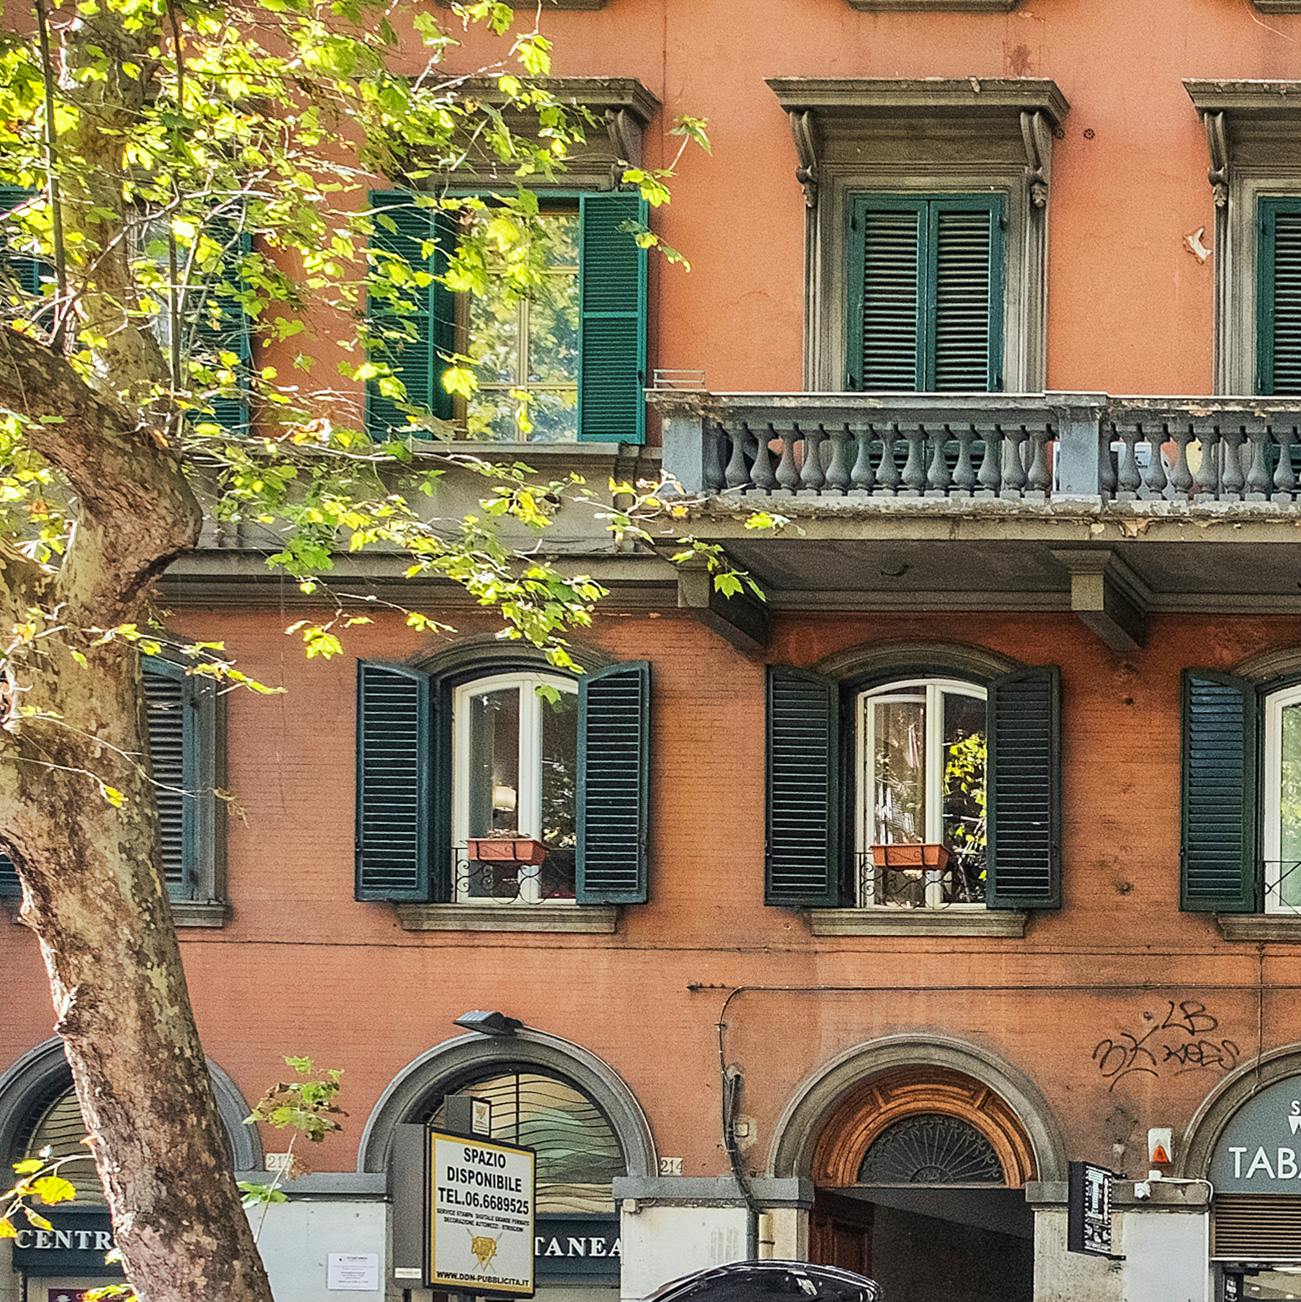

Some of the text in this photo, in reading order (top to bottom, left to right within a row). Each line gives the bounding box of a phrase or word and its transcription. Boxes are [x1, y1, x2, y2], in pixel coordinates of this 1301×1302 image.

[464, 1147, 506, 1169] SPAZIO
[660, 1159, 683, 1174] 214
[447, 1166, 522, 1192] DISPONIBILE
[14, 1229, 117, 1250] CENTR
[535, 1237, 621, 1257] TANEA
